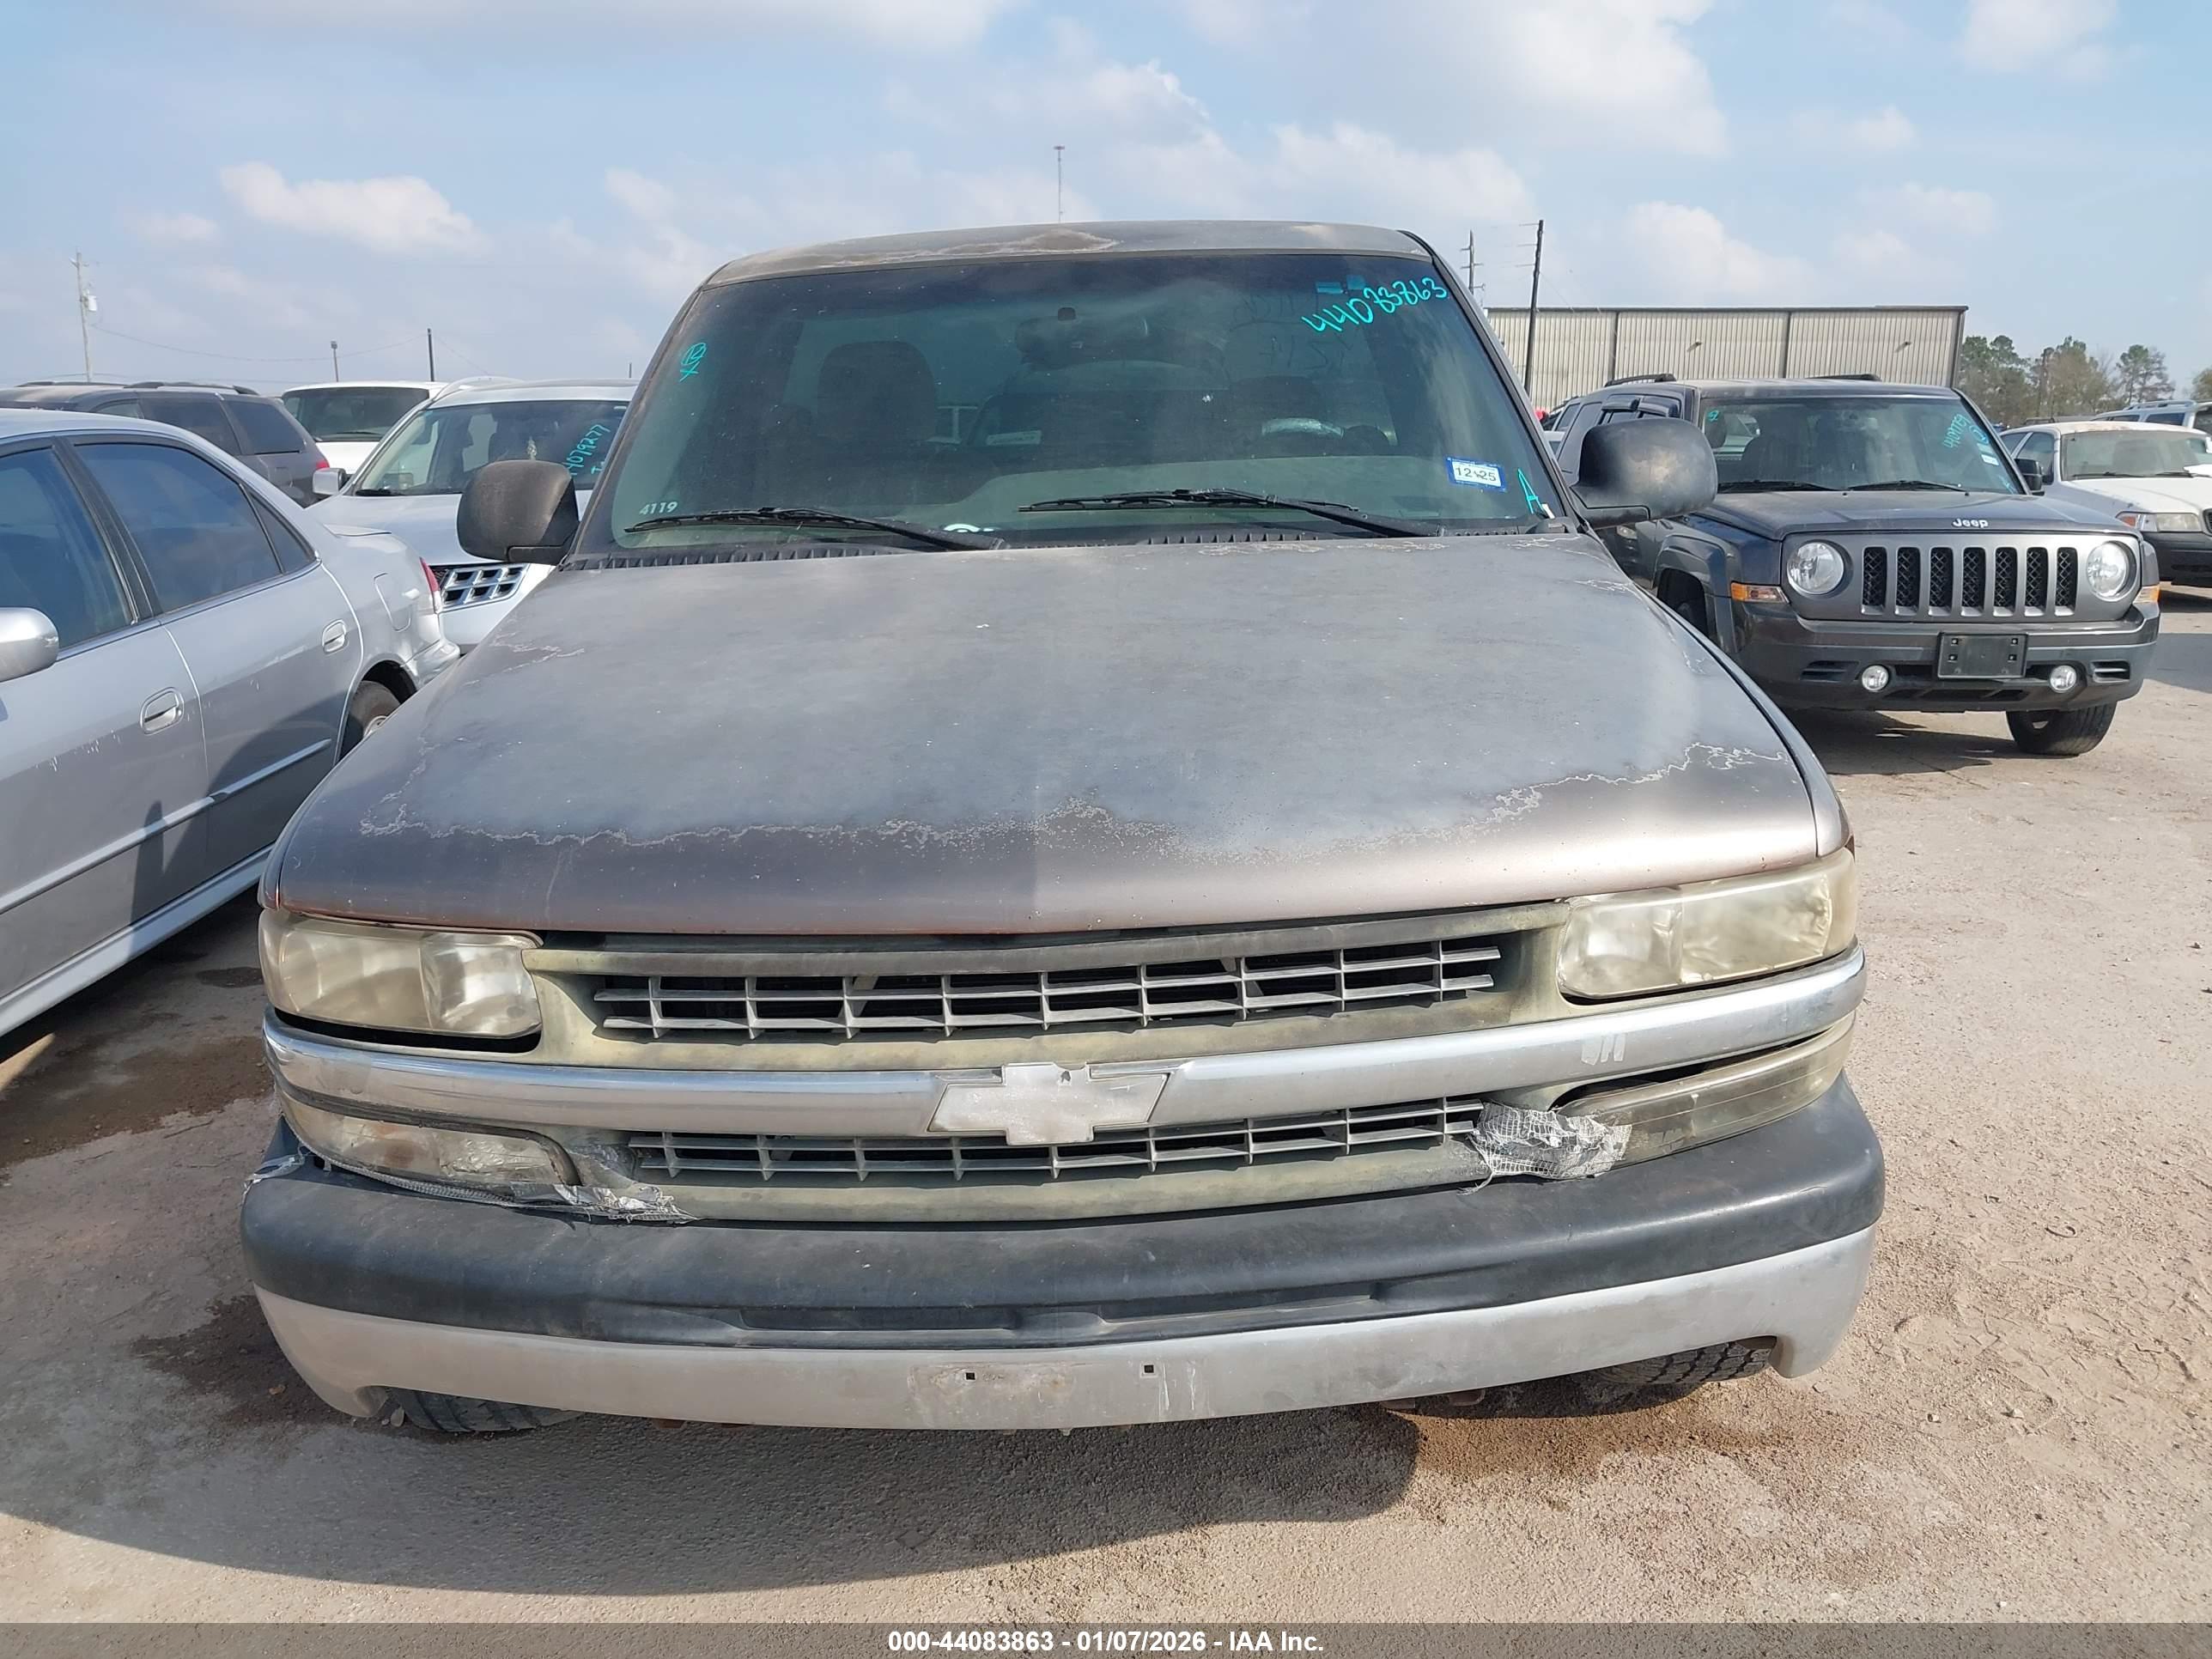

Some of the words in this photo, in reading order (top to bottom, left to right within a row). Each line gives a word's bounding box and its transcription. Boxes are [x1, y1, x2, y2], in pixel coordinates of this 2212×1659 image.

[1301, 277, 1448, 331] 44083863
[562, 424, 611, 476] 4079277
[639, 501, 678, 515] 4119
[1952, 518, 1989, 528] Jeep
